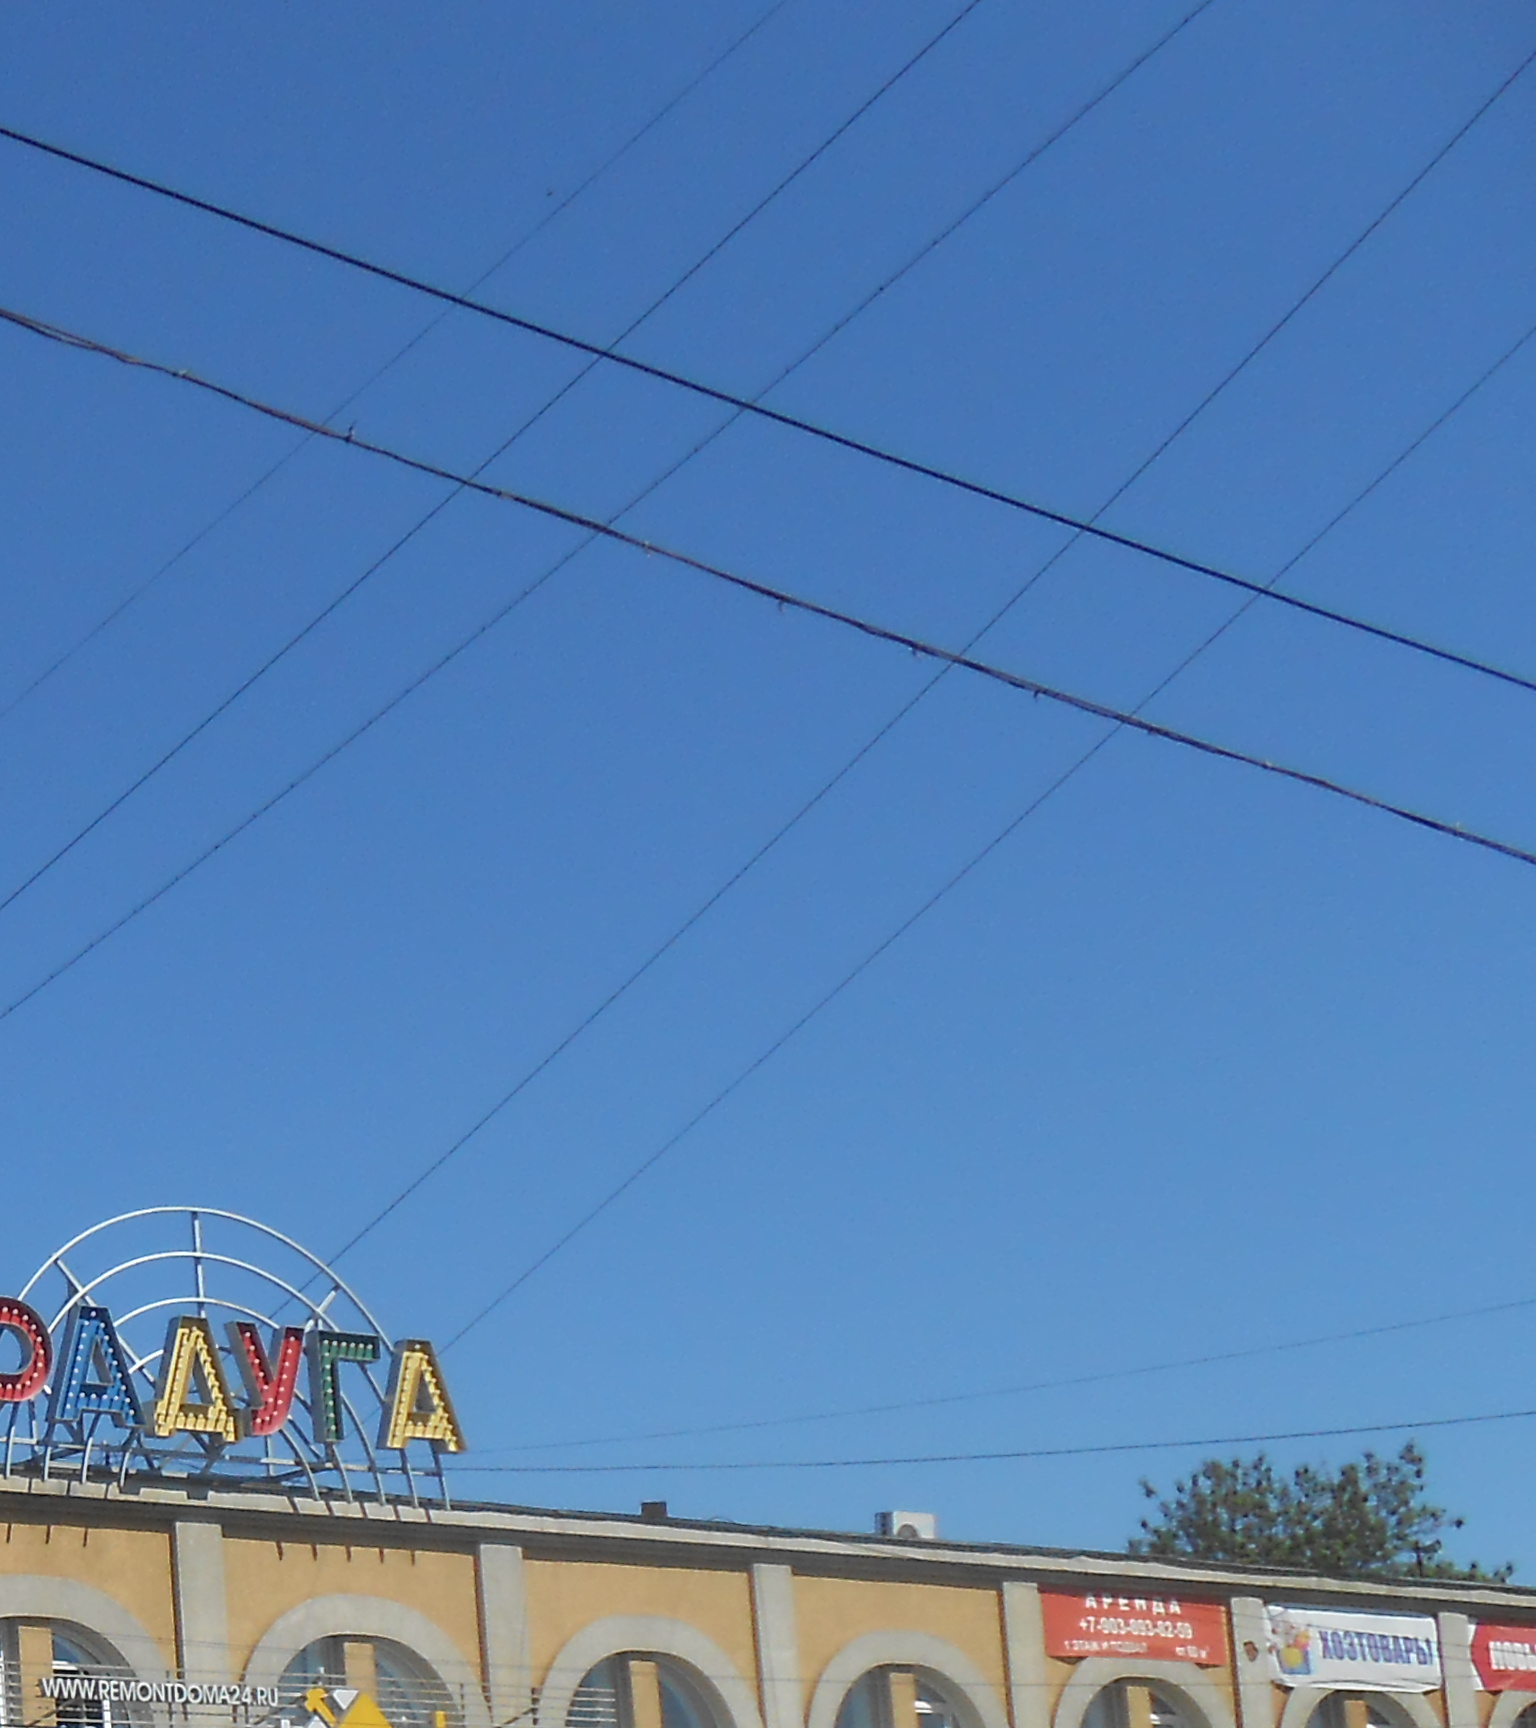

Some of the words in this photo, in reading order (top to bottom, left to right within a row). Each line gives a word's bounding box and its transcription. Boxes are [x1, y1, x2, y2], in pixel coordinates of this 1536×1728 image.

[1085, 1593, 1181, 1615] АРЕНДА
[1319, 1630, 1434, 1665] ХОЗТОВАРЫ
[41, 1677, 279, 1708] WWW.REMONTDOMA24.RU
